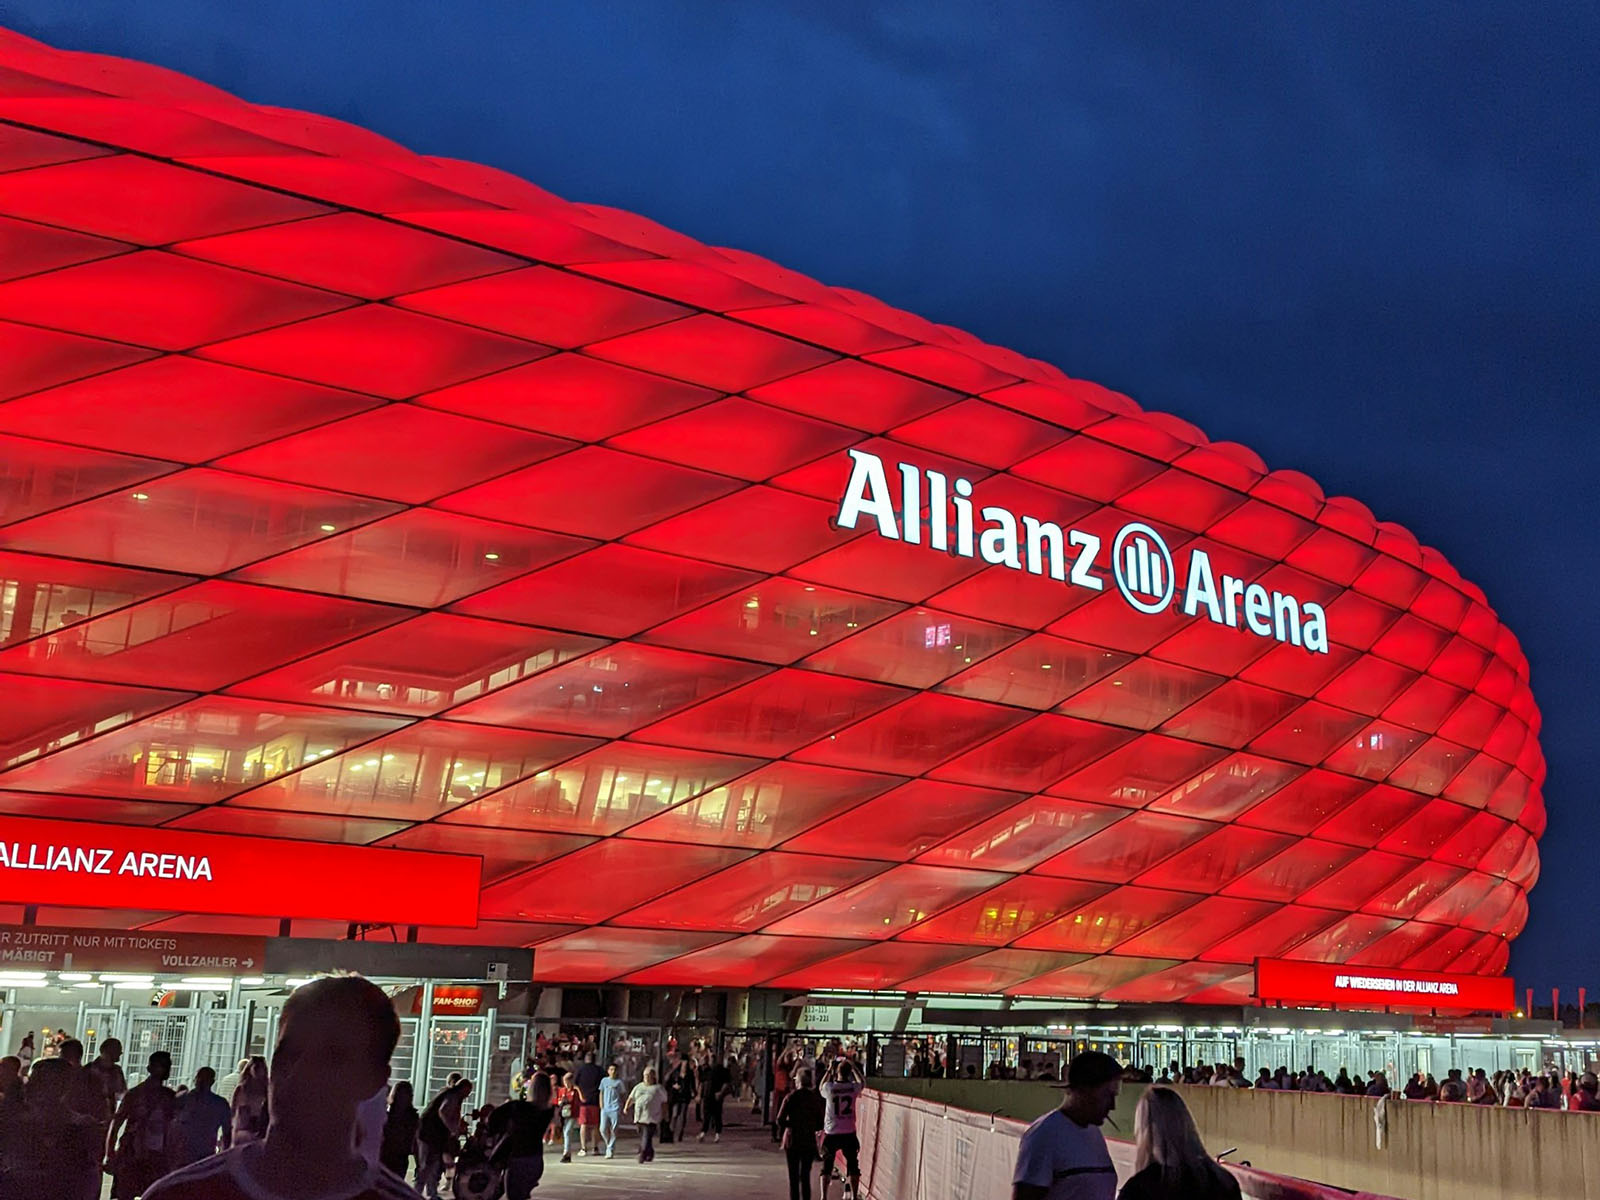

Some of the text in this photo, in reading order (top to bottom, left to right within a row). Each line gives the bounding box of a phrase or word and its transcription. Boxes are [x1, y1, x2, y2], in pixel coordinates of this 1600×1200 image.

[837, 449, 1329, 654] Allianz Arena
[118, 851, 213, 881] ARENA
[14, 932, 69, 946] ZUTRITT
[73, 935, 100, 946] NUR
[104, 936, 126, 947] MIT
[128, 937, 177, 950] TICKETS
[162, 955, 237, 968] VOLLZAHLER
[1335, 975, 1459, 995] AUF WIEDERSEHEN IN DER ALLIANZ ARENA
[433, 998, 478, 1006] FAN-SHOP
[833, 1096, 853, 1115] 12
